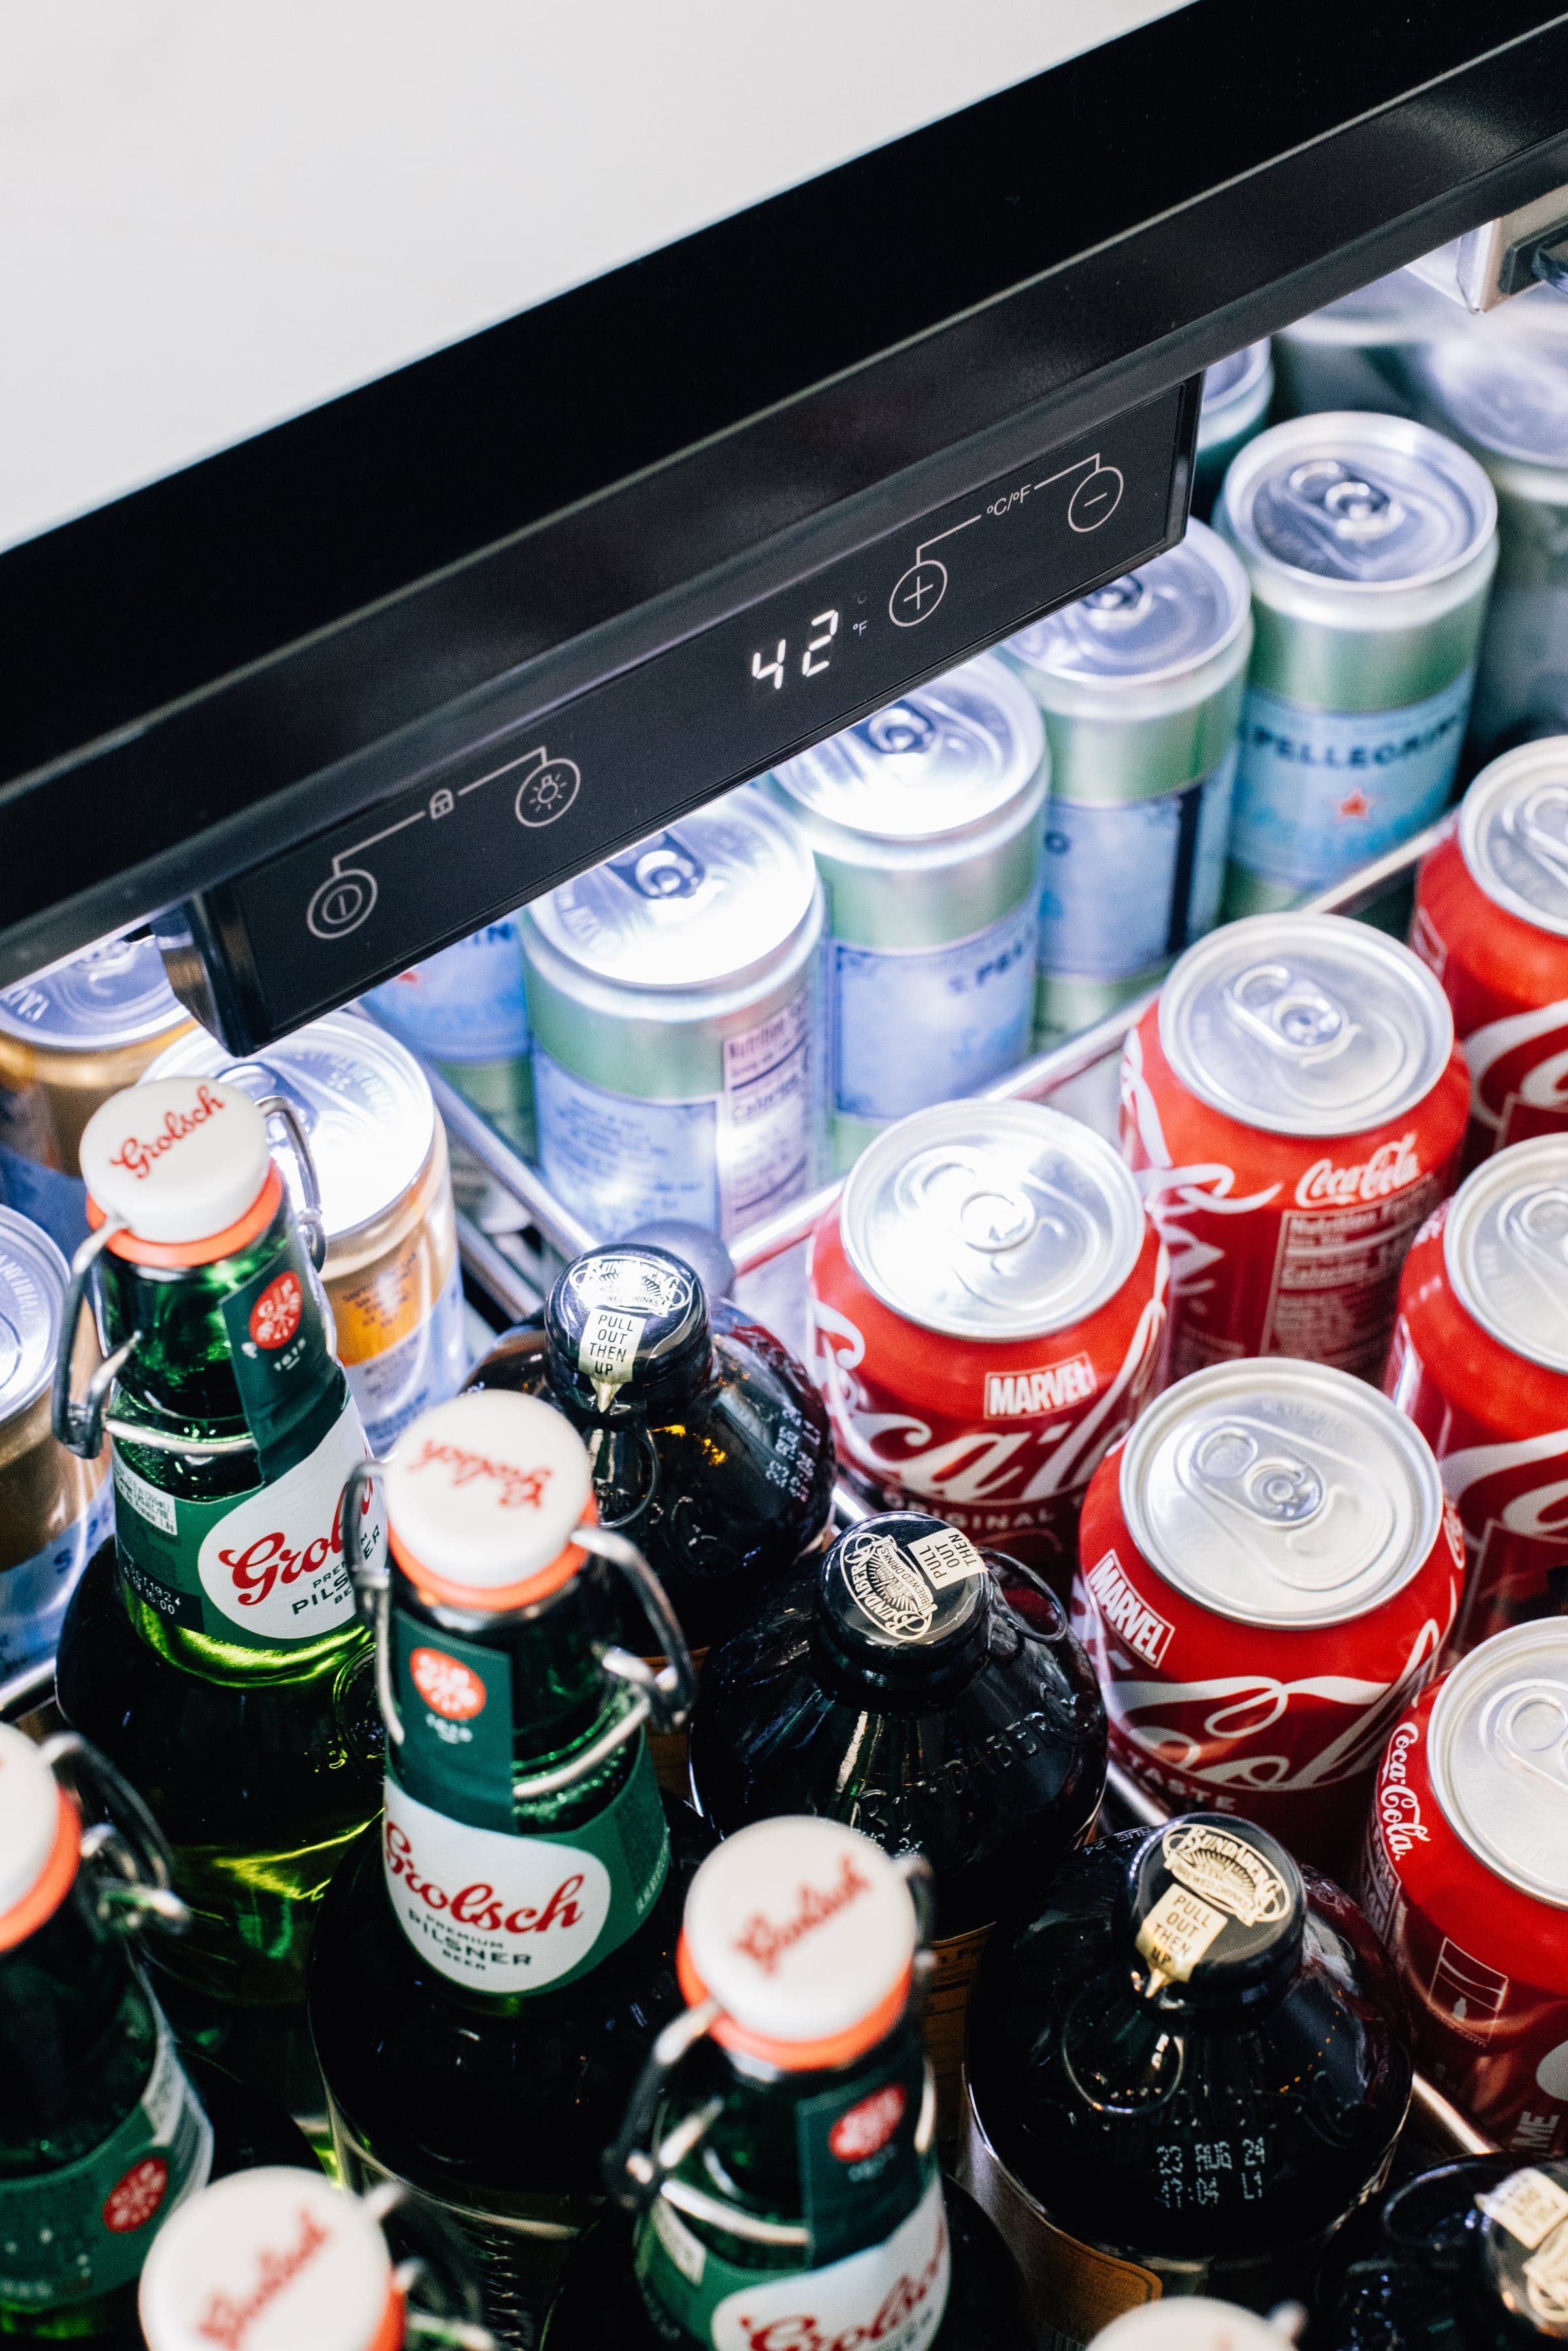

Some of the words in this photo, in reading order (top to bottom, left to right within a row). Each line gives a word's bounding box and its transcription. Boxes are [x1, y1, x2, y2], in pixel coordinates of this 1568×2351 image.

[752, 609, 839, 689] 42
[109, 1085, 226, 1180] Grolsch
[597, 1328, 628, 1345] OUT
[598, 1314, 634, 1332] PULL
[589, 1342, 627, 1363] THEN
[594, 1360, 614, 1376] UP
[989, 1360, 1095, 1416] MARVEL
[881, 1547, 905, 1574] DRINKS
[919, 1545, 948, 1580] PULL
[935, 1542, 960, 1569] OUT
[949, 1533, 978, 1567] THEN
[843, 1542, 921, 1634] BUNDABERG
[1088, 1562, 1168, 1665] MARVEL
[1380, 1721, 1431, 1858] Coca-Cola
[386, 1820, 585, 1934] Grolsch
[1176, 1826, 1282, 1908] BUNDABERG
[1166, 1911, 1200, 1938] OUT
[1172, 1894, 1213, 1928] PULL
[1152, 1922, 1192, 1955] THEN
[1242, 2135, 1266, 2167] 24
